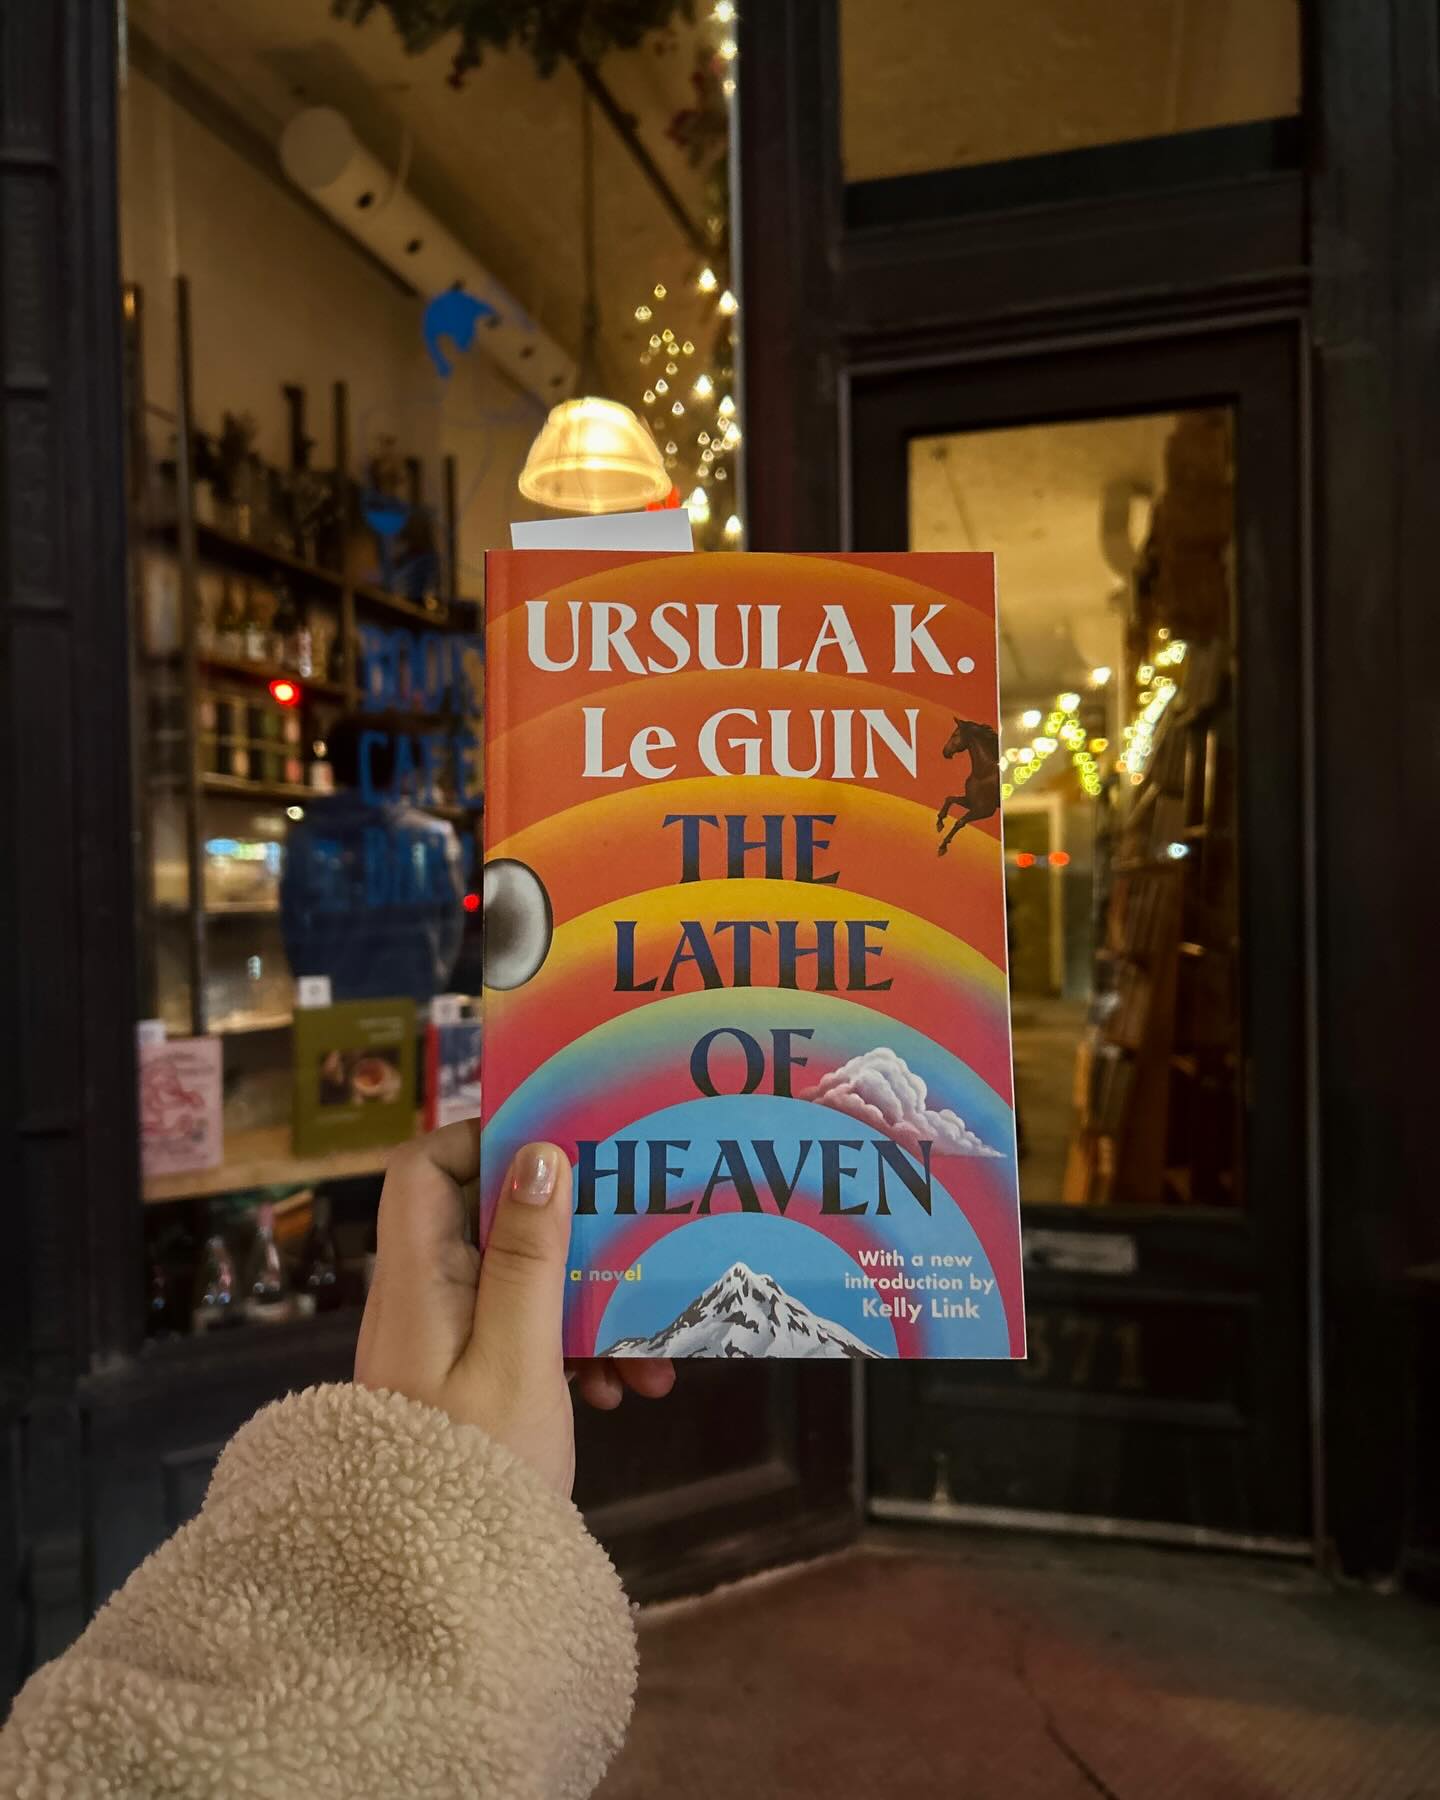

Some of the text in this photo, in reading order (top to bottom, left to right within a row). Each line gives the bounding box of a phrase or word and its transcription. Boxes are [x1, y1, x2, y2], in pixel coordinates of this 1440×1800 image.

[525, 601, 976, 675] URSULA K.
[582, 707, 920, 778] Le GUIN
[662, 814, 840, 884] THE
[613, 920, 893, 992] LATHE
[690, 1027, 815, 1098] OF
[573, 1140, 932, 1216] HEAVEN
[570, 1263, 642, 1281] a novel
[844, 1272, 995, 1295] introduction by
[858, 1249, 973, 1267] With a new
[862, 1296, 981, 1324] Kelly Link
